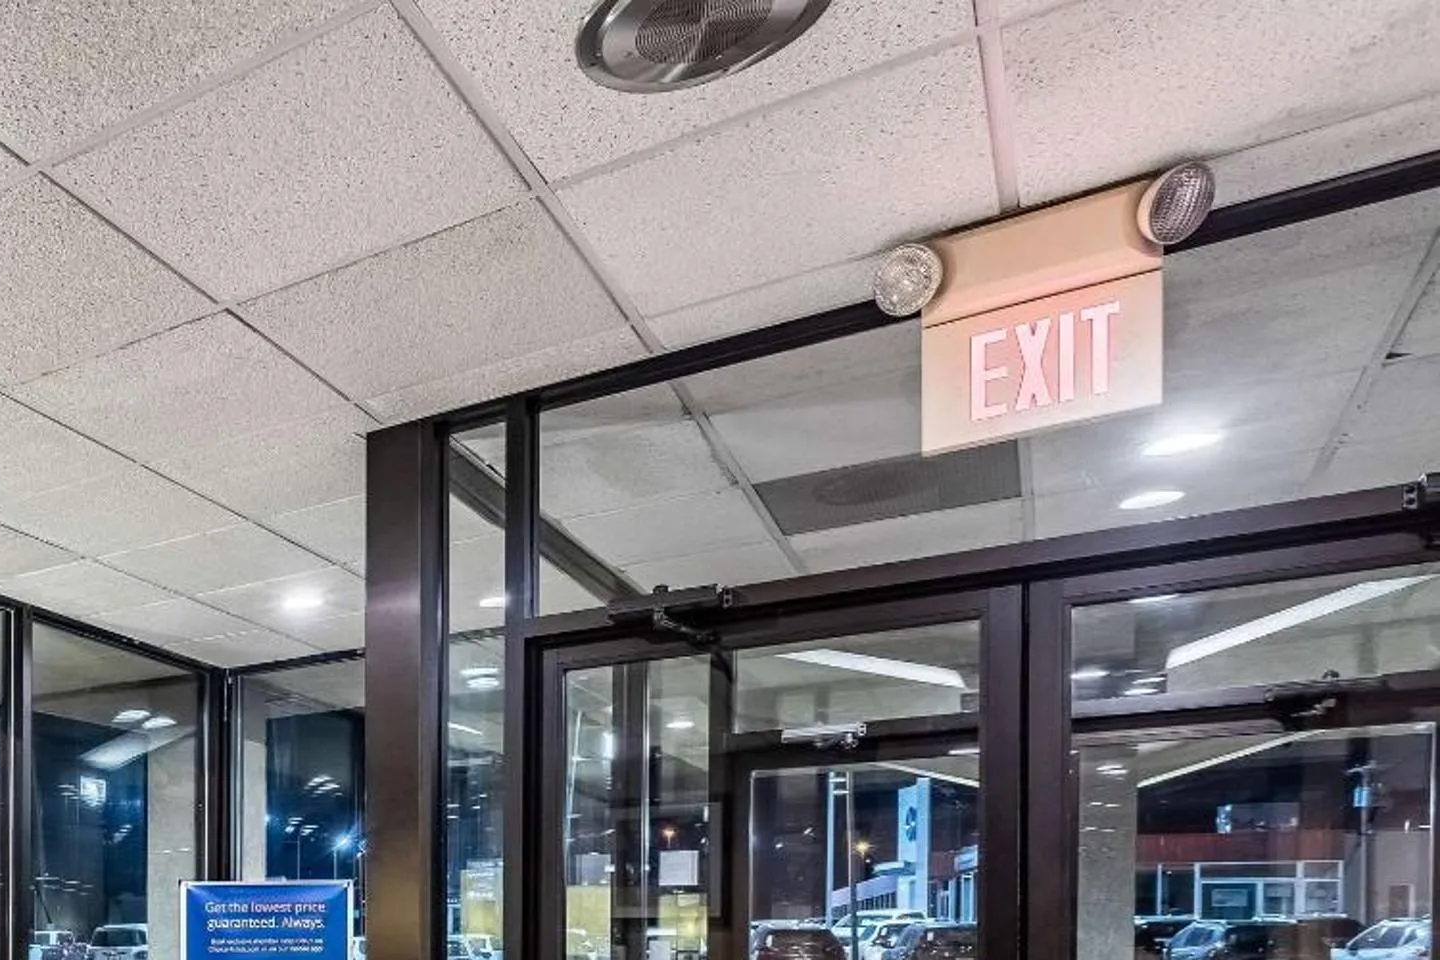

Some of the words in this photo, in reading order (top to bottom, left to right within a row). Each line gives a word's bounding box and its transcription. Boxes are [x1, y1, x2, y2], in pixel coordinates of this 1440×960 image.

[969, 299, 1121, 422] EXIT
[205, 901, 226, 913] Get
[228, 901, 249, 913] the
[251, 901, 292, 913] lowest
[294, 902, 326, 915] price
[207, 916, 279, 932] guaranteed.
[282, 915, 325, 930] Always.
